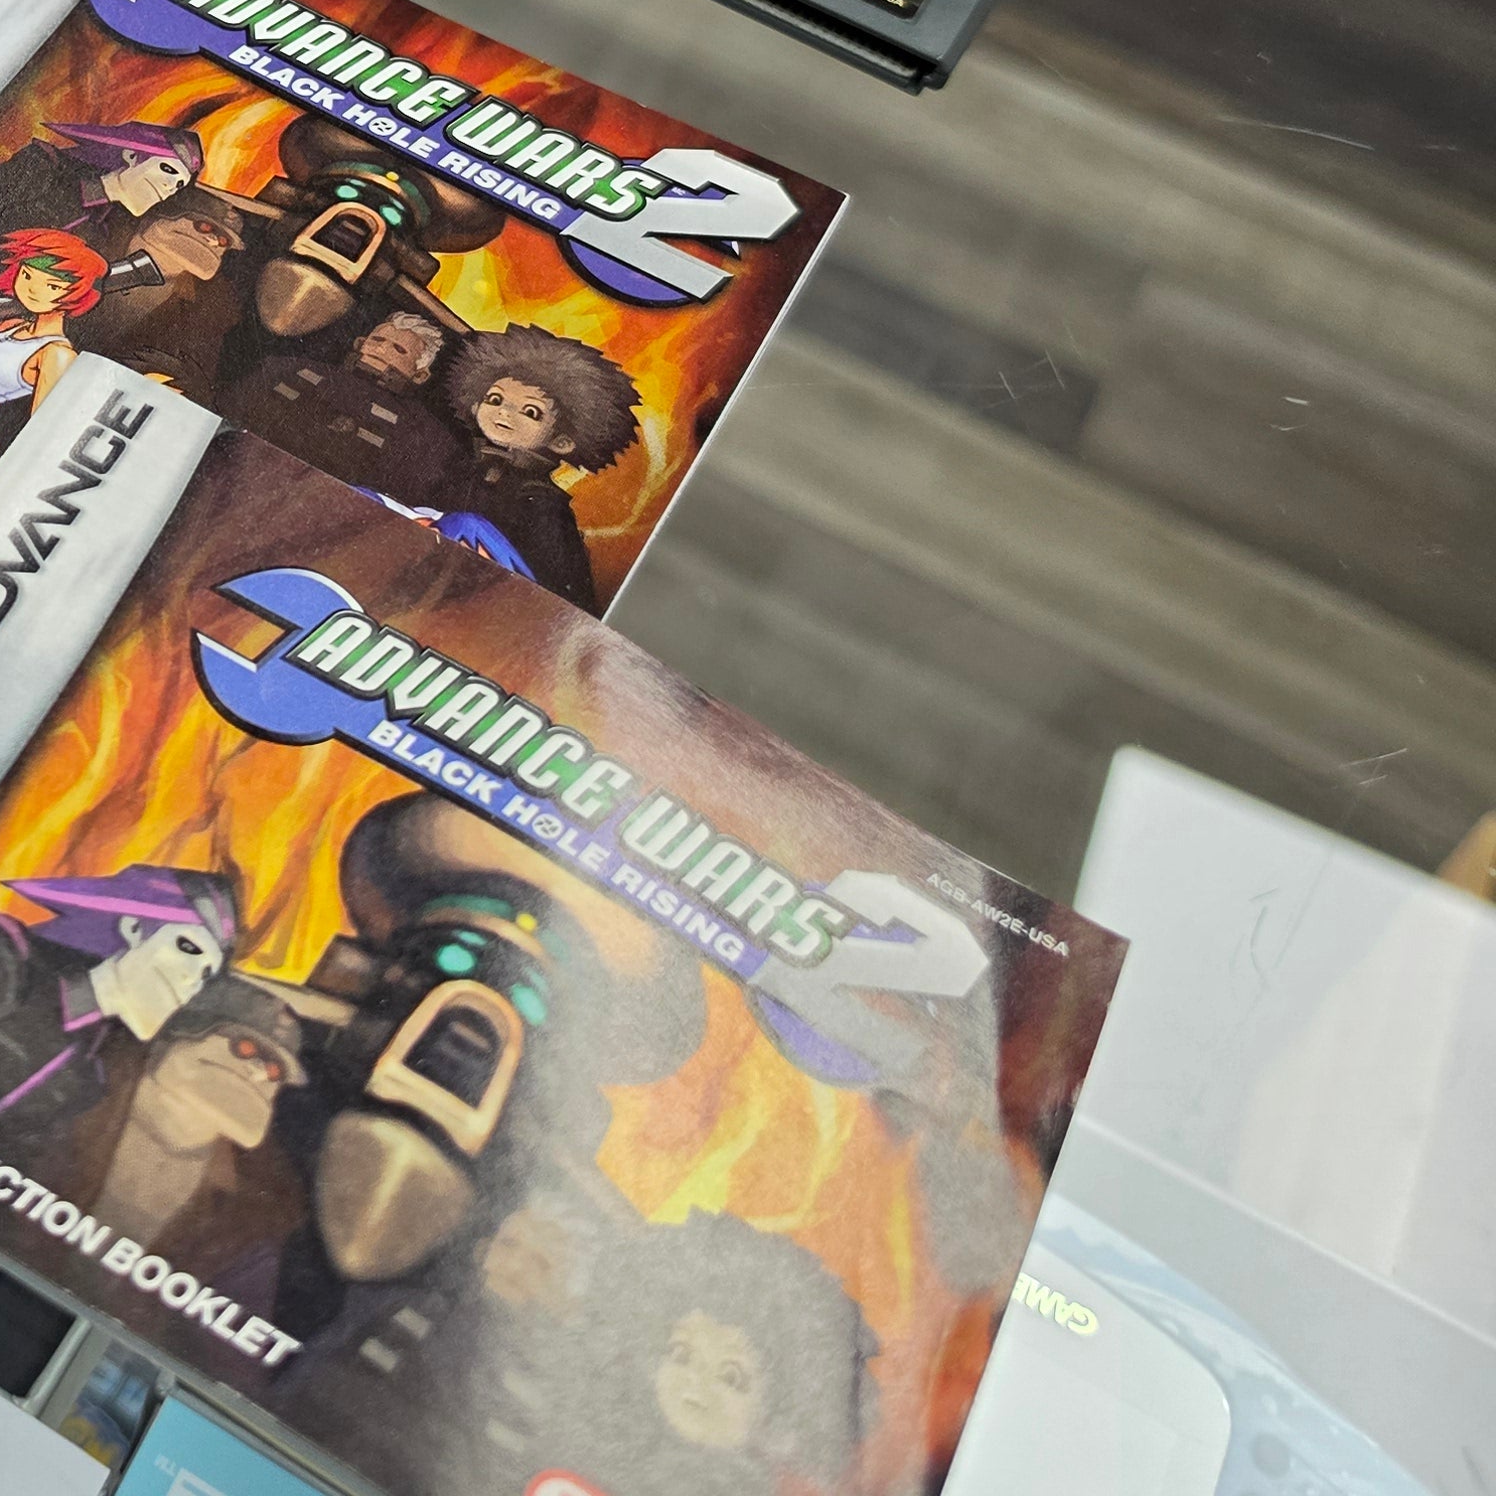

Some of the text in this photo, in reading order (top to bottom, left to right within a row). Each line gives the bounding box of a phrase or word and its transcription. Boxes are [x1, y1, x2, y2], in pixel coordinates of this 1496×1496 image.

[227, 45, 564, 221] BLACK HOLE RISING
[444, 95, 666, 222] WARS
[560, 148, 799, 302] 2
[294, 608, 991, 1070] ADVANCE WARS 2
[367, 720, 749, 965] BLACK HOLE RISING
[925, 870, 1071, 959] AGB-AW2E-USA
[100, 1236, 304, 1369] BOOKLET
